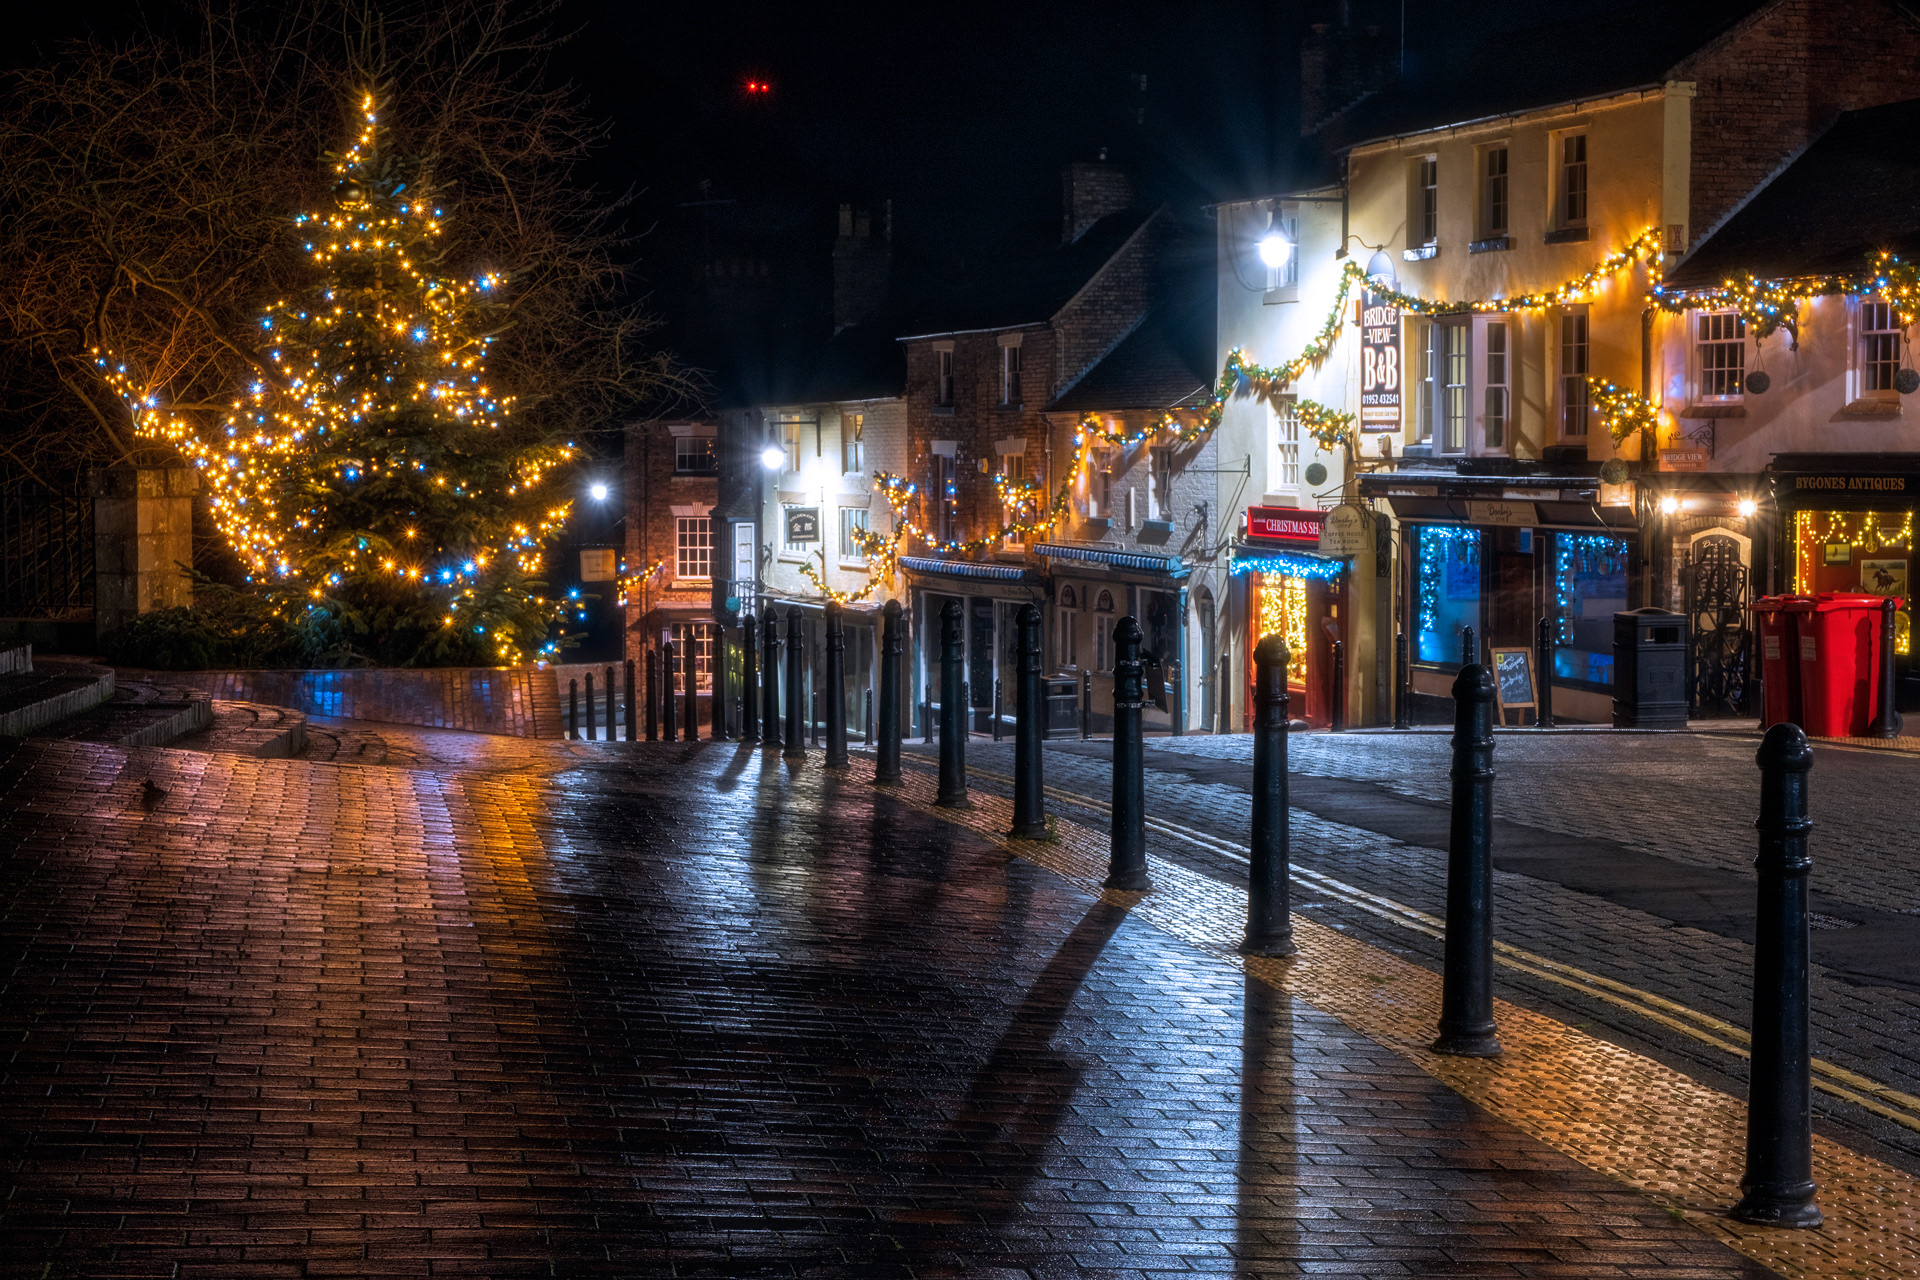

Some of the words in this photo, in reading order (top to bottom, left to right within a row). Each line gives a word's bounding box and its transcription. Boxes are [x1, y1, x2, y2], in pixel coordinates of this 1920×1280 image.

[1363, 306, 1397, 327] BRIDGE
[1363, 345, 1398, 391] B&B
[1362, 394, 1378, 405] 01952
[1380, 394, 1399, 404] 432541
[1662, 453, 1686, 461] BRIDGE
[1795, 477, 1846, 490] BYGONES
[1848, 477, 1905, 491] ANTIQUES
[1710, 500, 1739, 508] ENTRANCE
[1487, 503, 1513, 523] Darby's
[1266, 518, 1308, 534] CHRISTMAS
